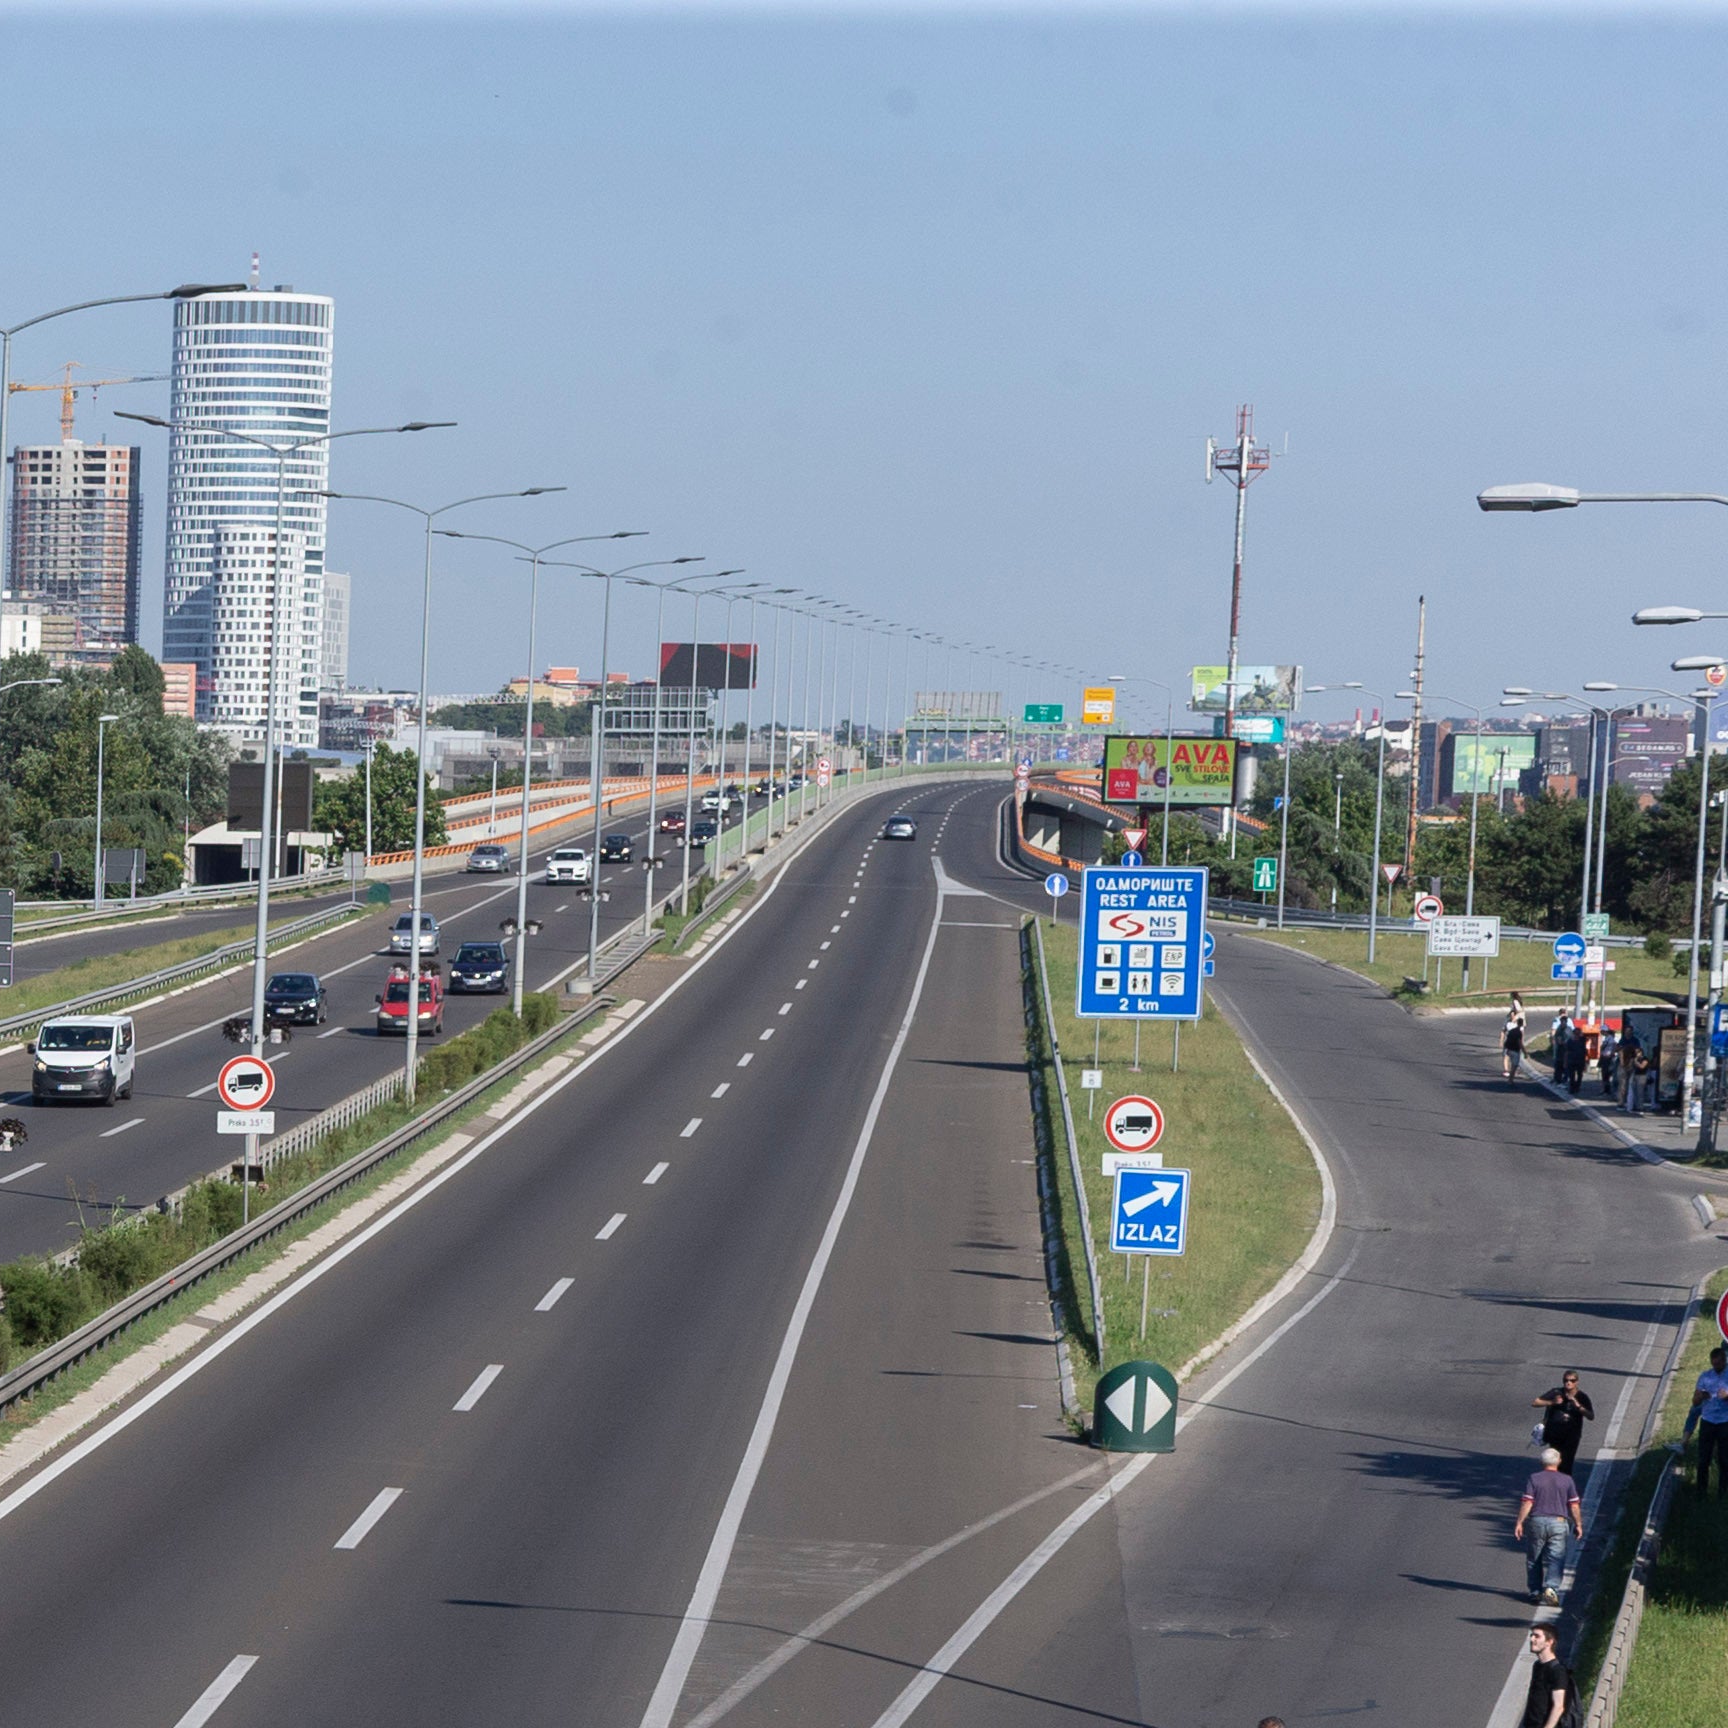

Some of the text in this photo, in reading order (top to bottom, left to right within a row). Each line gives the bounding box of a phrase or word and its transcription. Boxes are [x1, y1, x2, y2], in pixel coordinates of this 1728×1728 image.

[1172, 743, 1230, 764] AVA
[1175, 764, 1230, 773] SVE STILOVE
[1114, 780, 1131, 788] AVA
[1202, 774, 1230, 783] SPAJA
[1096, 877, 1194, 892] ОДМОРИШТЕ
[1099, 894, 1187, 908] REST AREA
[1149, 916, 1177, 927] NIS
[1119, 998, 1159, 1011] 2 km
[1119, 1223, 1177, 1243] IZLAZ
